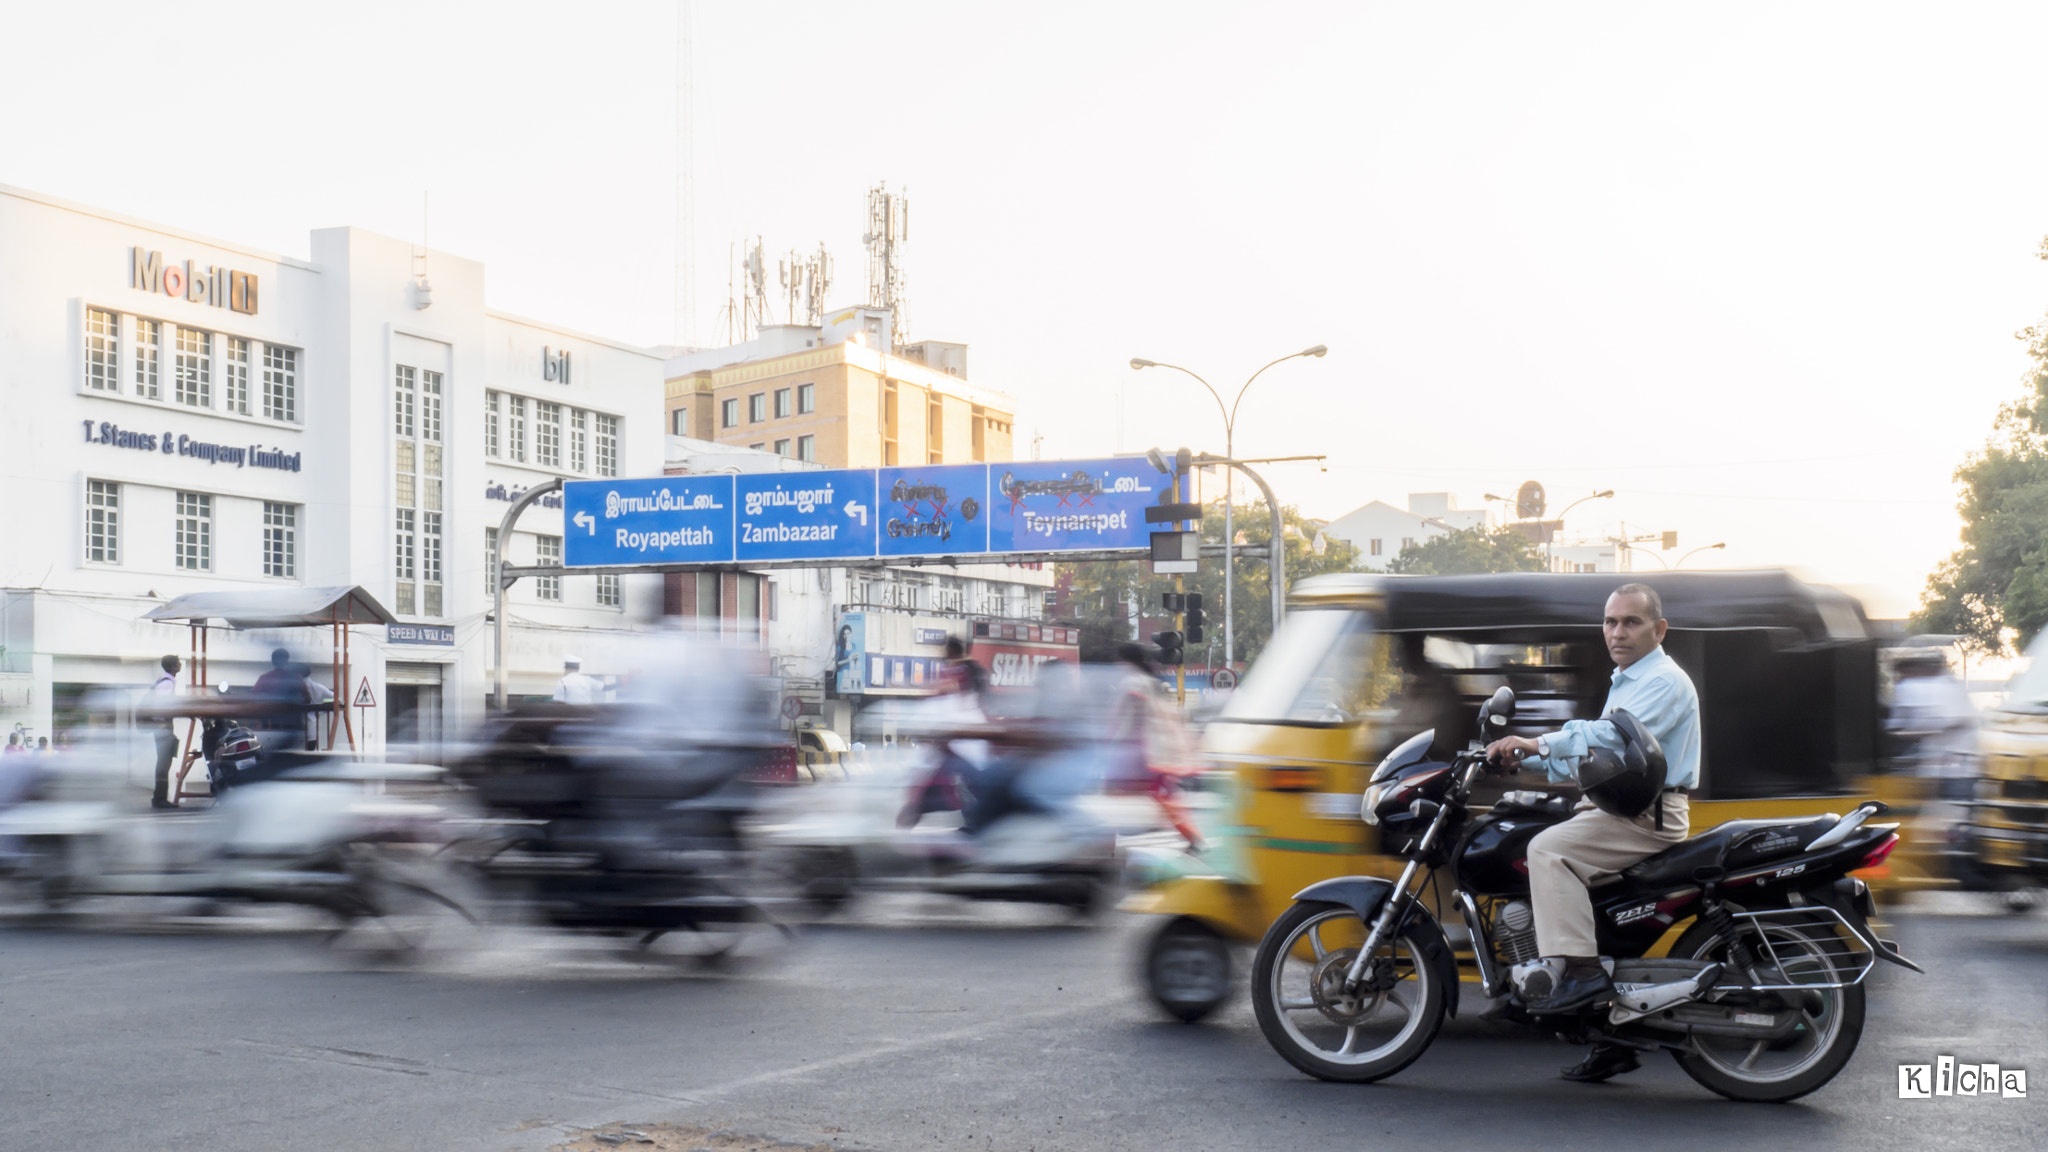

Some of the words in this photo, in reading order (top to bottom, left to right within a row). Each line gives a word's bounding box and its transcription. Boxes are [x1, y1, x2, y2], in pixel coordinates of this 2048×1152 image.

[132, 245, 226, 309] Mobil
[162, 431, 175, 454] &
[179, 434, 246, 468] Company
[250, 444, 301, 473] Limited
[605, 487, 723, 519] இராயப்பேட்டை
[745, 482, 834, 516] ஜாம்பஜார்
[742, 522, 838, 544] Zambazaar
[1023, 509, 1128, 538] Teynampet
[616, 525, 713, 552] Royapettah
[390, 627, 416, 640] SPEED
[417, 629, 423, 641] A
[423, 628, 439, 641] WAY
[1775, 864, 1806, 878] 125
[1615, 902, 1657, 921] ZEUS
